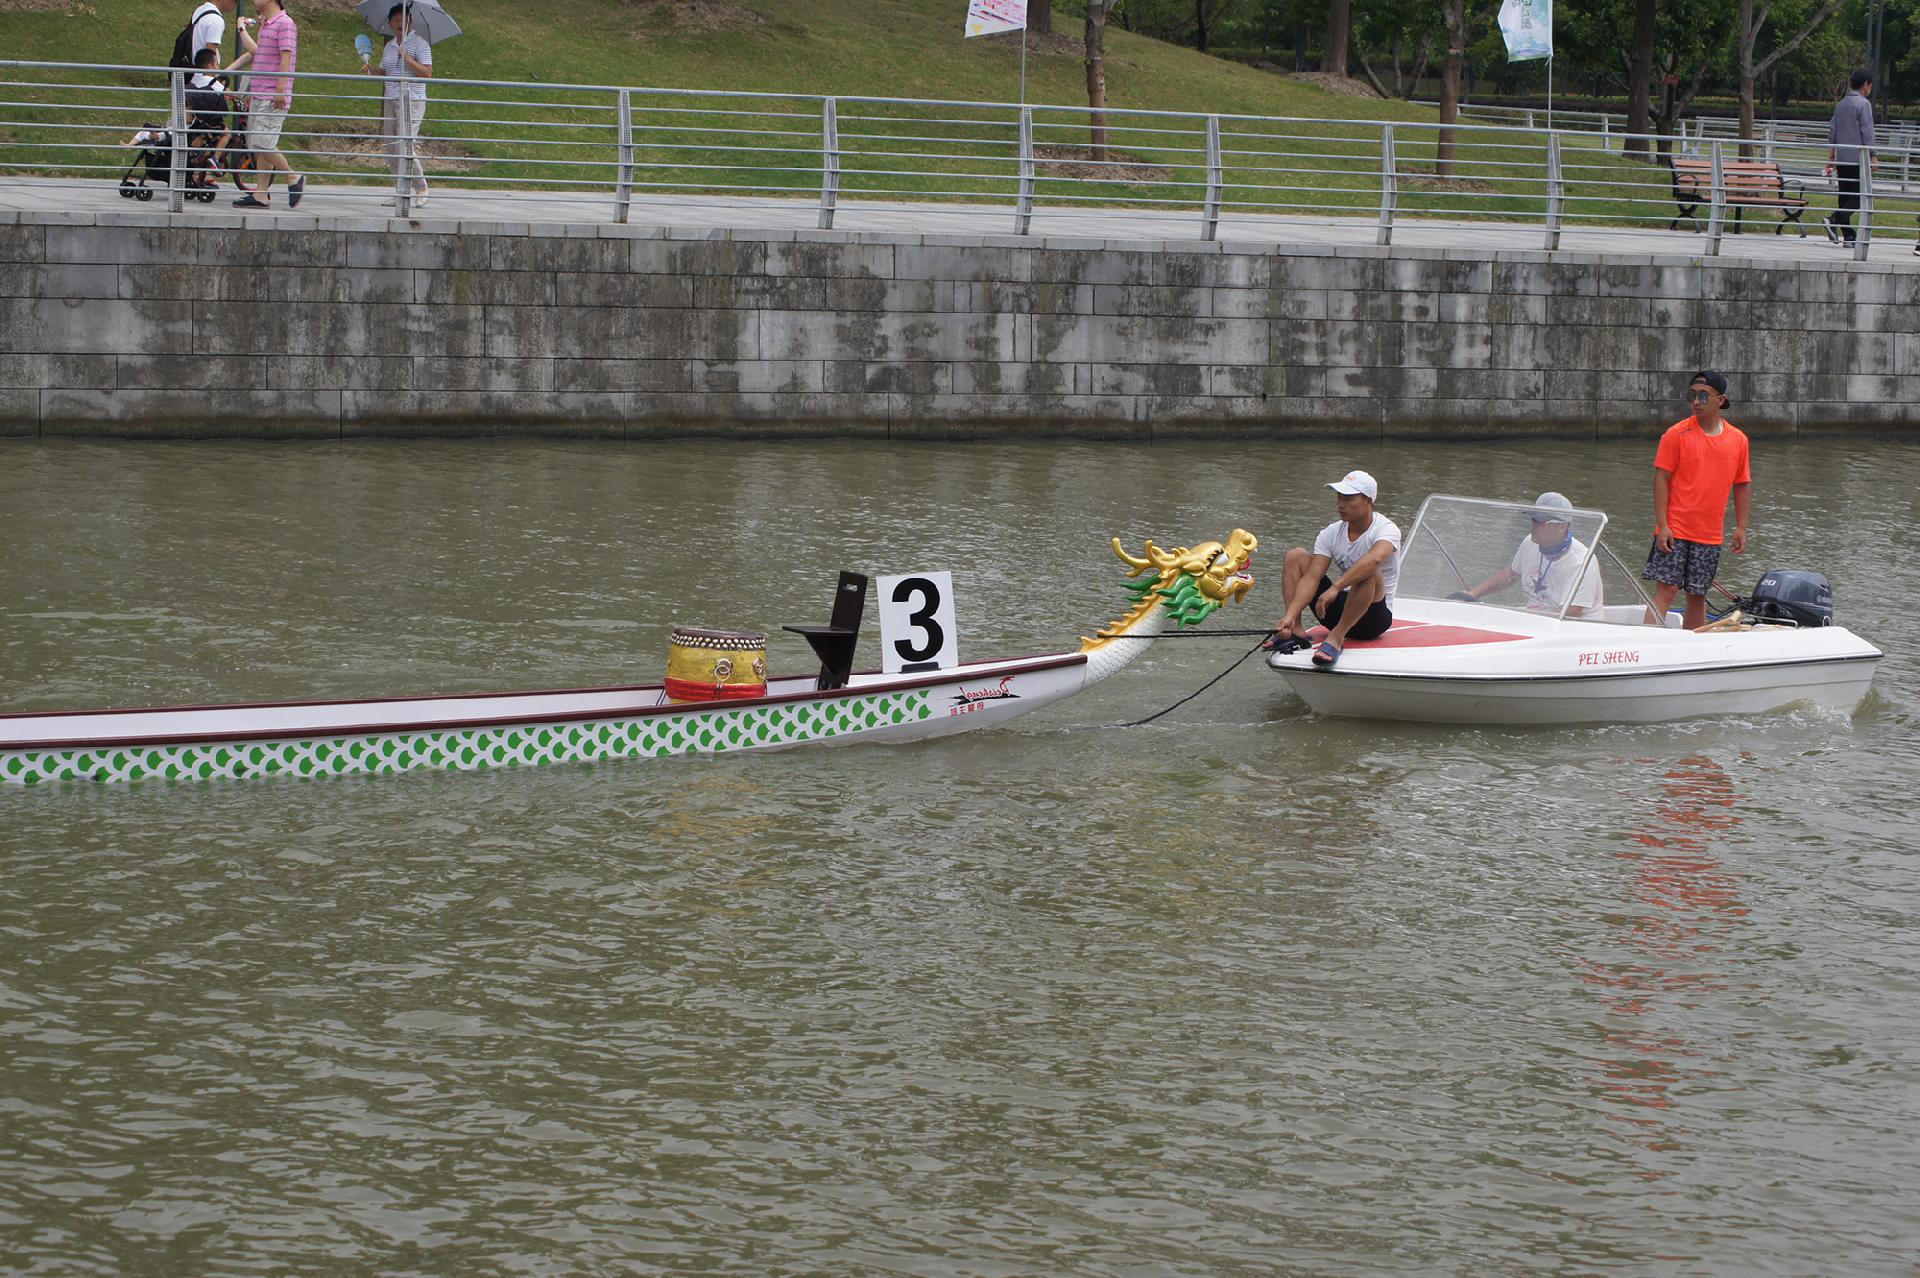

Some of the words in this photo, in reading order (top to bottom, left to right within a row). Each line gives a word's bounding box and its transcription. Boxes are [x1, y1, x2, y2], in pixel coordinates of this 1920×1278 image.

[892, 577, 944, 662] 3
[1579, 652, 1599, 666] PEI
[1602, 650, 1640, 665] SHENG
